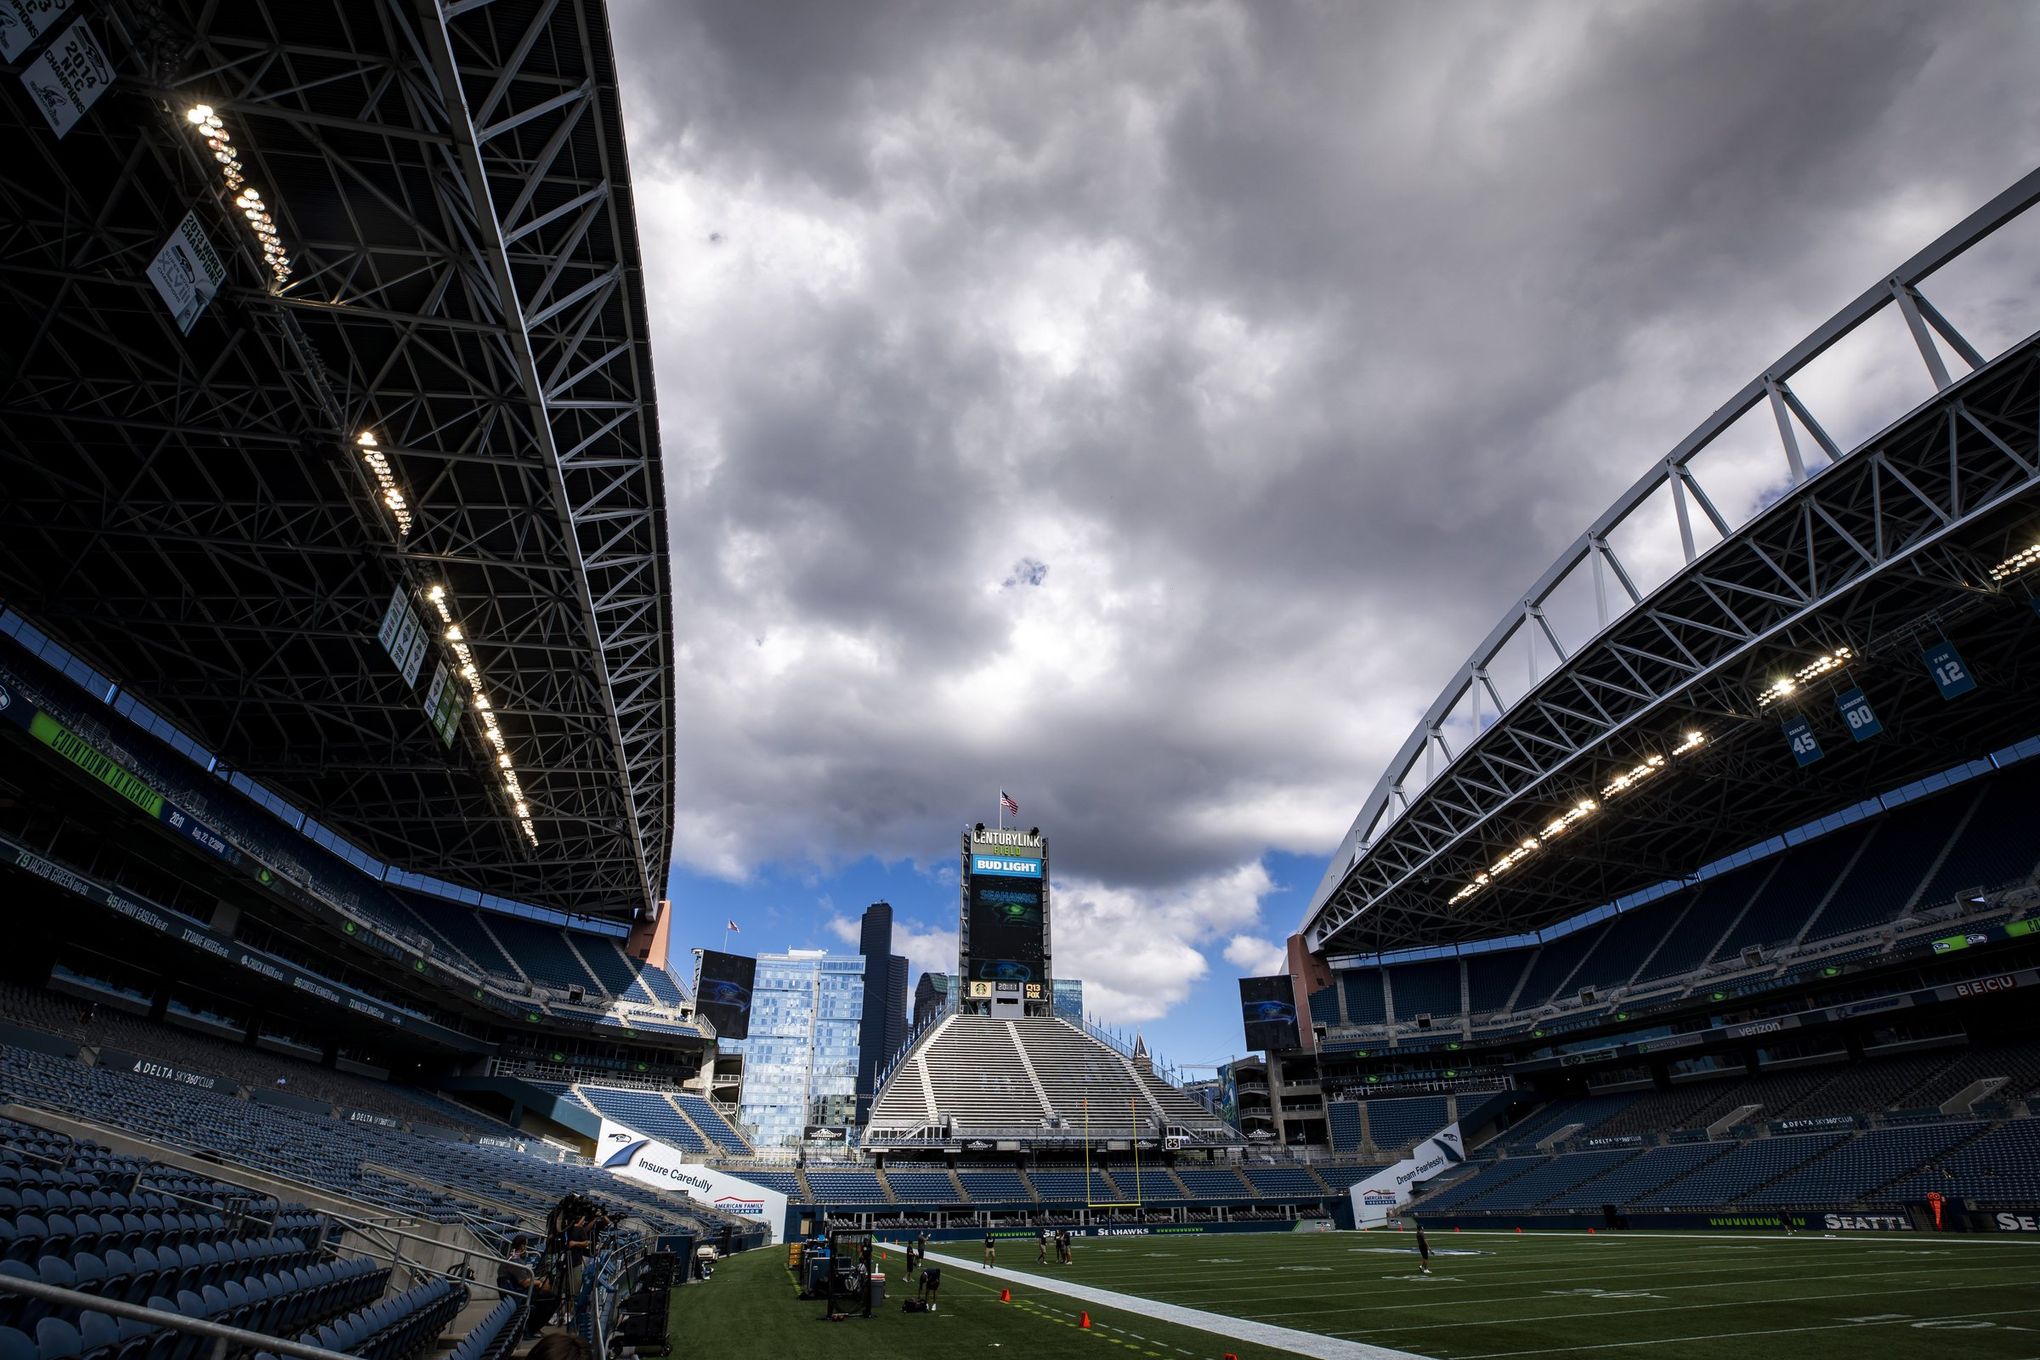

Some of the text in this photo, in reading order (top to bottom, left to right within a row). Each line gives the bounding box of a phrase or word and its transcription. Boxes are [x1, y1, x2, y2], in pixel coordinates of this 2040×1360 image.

[60, 57, 84, 92] NFC
[65, 41, 97, 88] 2014
[44, 49, 86, 114] CHAMPIONS
[181, 222, 220, 286] CHAMPIONS
[186, 215, 224, 280] 2013 WORLD
[158, 251, 191, 304] XLVIII
[1936, 660, 1965, 687] 12
[1846, 705, 1874, 730] 80
[1792, 732, 1817, 754] 45
[51, 729, 159, 811] COUNTDOWN TO KICKOFF
[973, 831, 1041, 848] CENTURYLINK
[993, 846, 1021, 857] FIELD
[15, 851, 31, 868] 79
[26, 857, 52, 878] JACOB
[50, 868, 76, 892] GREEN
[977, 860, 1037, 873] BUD LIGHT
[105, 894, 119, 910] 45
[115, 899, 139, 918] KENNY
[135, 908, 160, 927] EASLEY
[181, 928, 192, 941] 17
[996, 982, 1018, 991] 20:11
[1025, 983, 1041, 993] Q13
[1026, 991, 1041, 999] FOX
[1738, 1020, 1782, 1038] verizon
[143, 1062, 173, 1080] DELTA
[356, 1112, 373, 1124] DELTA
[1788, 1119, 1814, 1128] DELTA
[638, 1157, 713, 1193] Insure Carefully
[1396, 1155, 1445, 1185] Dream Fearlessly
